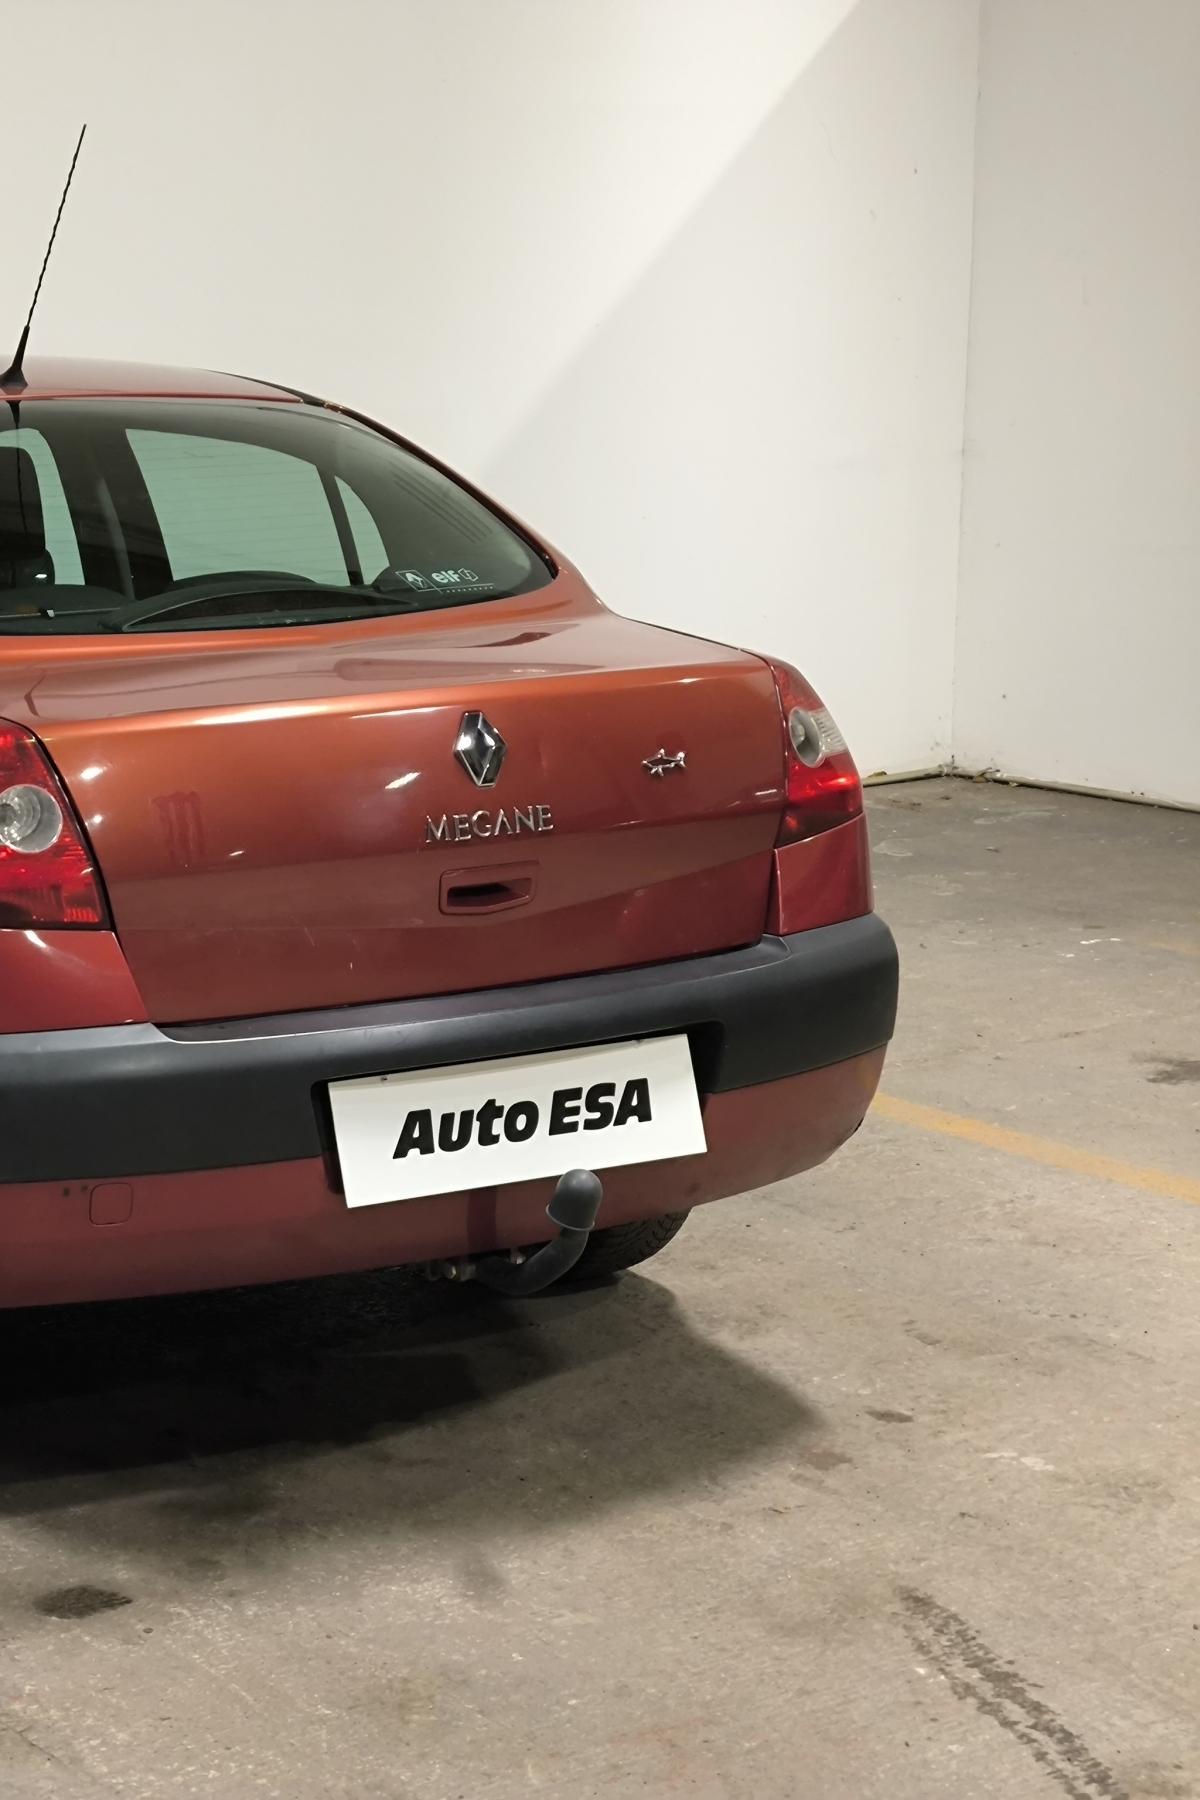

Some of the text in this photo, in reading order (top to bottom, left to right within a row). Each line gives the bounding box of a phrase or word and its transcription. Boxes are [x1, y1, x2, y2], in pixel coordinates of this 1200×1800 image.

[431, 570, 461, 583] elf
[425, 805, 554, 843] MEGANE
[392, 1077, 653, 1160] Auto ESA
